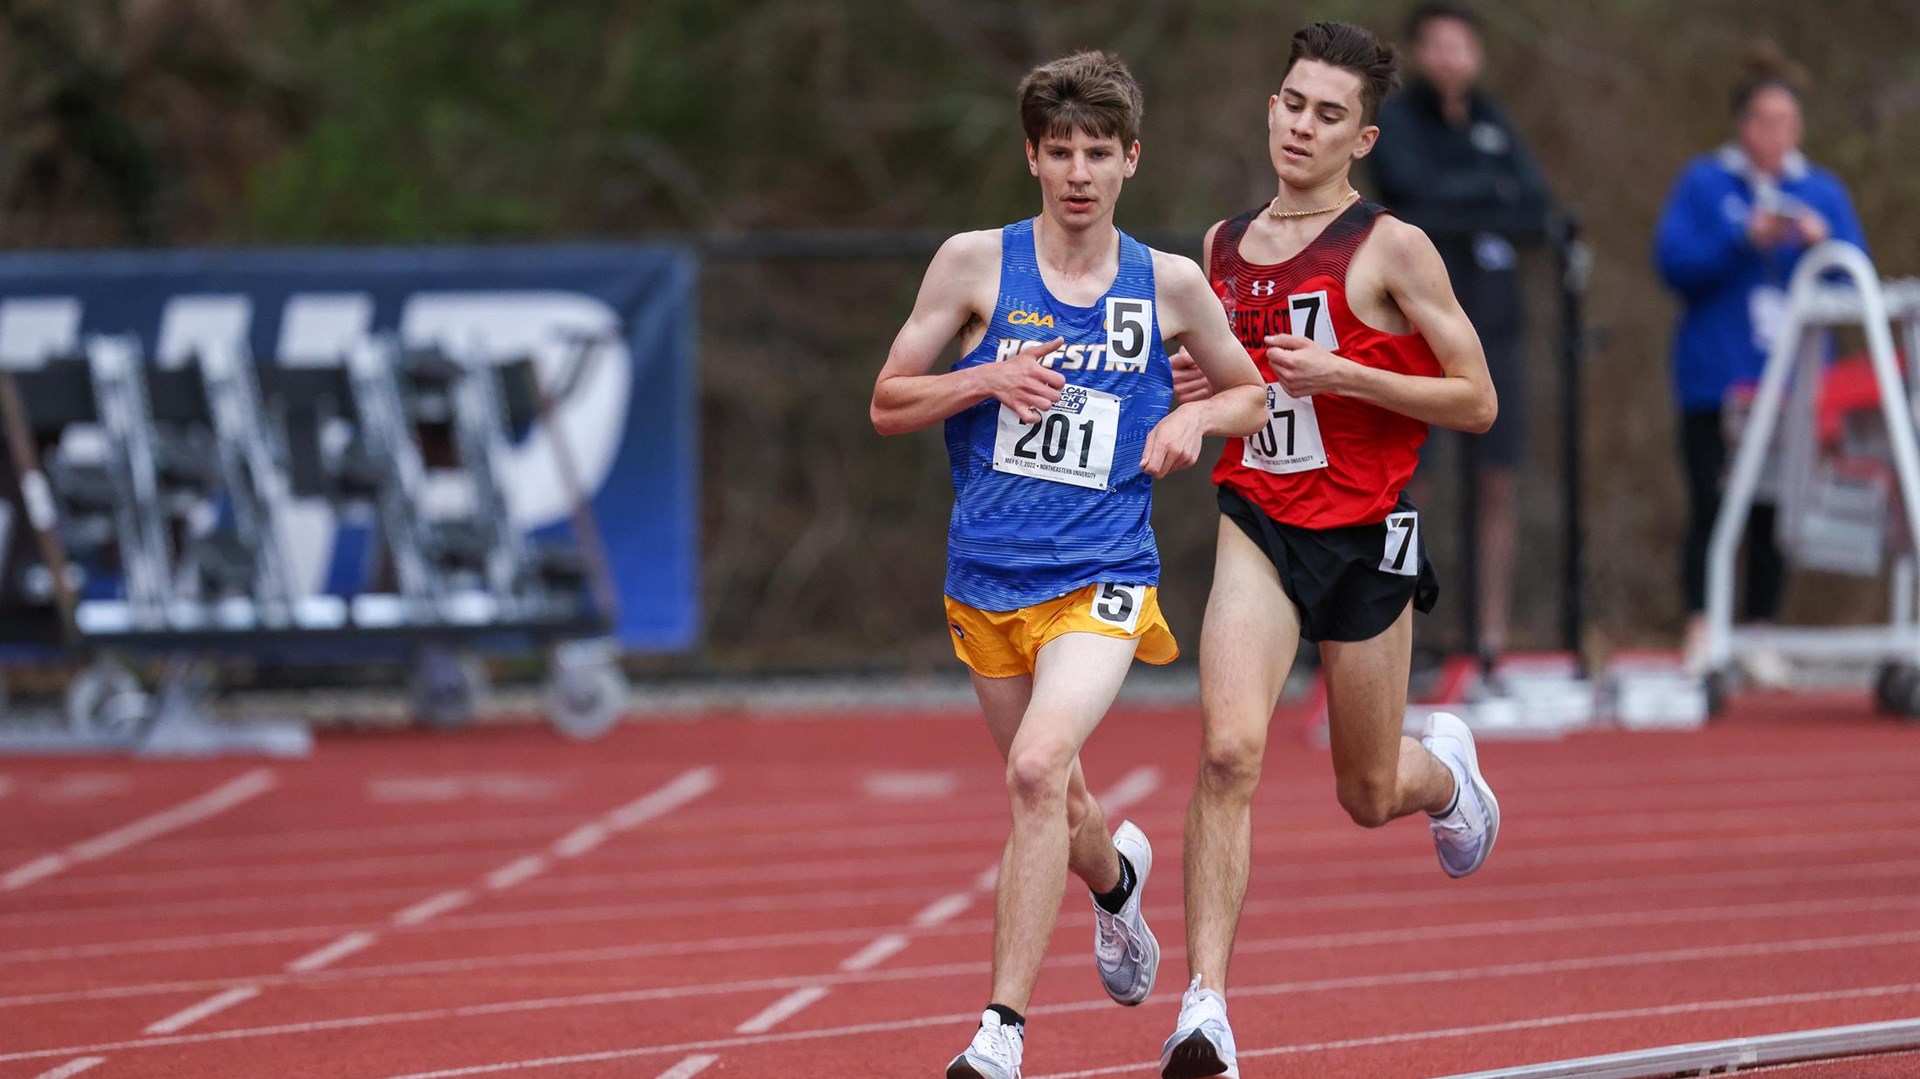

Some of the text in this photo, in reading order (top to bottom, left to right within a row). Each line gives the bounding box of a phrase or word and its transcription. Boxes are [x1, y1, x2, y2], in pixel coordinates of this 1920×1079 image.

[1007, 310, 1055, 328] CAA
[1112, 302, 1145, 359] 5
[1235, 309, 1291, 349] HEAST
[1292, 297, 1321, 342] 7
[1066, 386, 1088, 397] CAA
[1014, 409, 1094, 469] 201
[1024, 461, 1036, 469] 2022
[1040, 464, 1072, 475] NORTHEASTERN
[1073, 471, 1096, 479] UNIVERSITY
[1390, 518, 1415, 570] 7
[1098, 582, 1134, 622] 5
